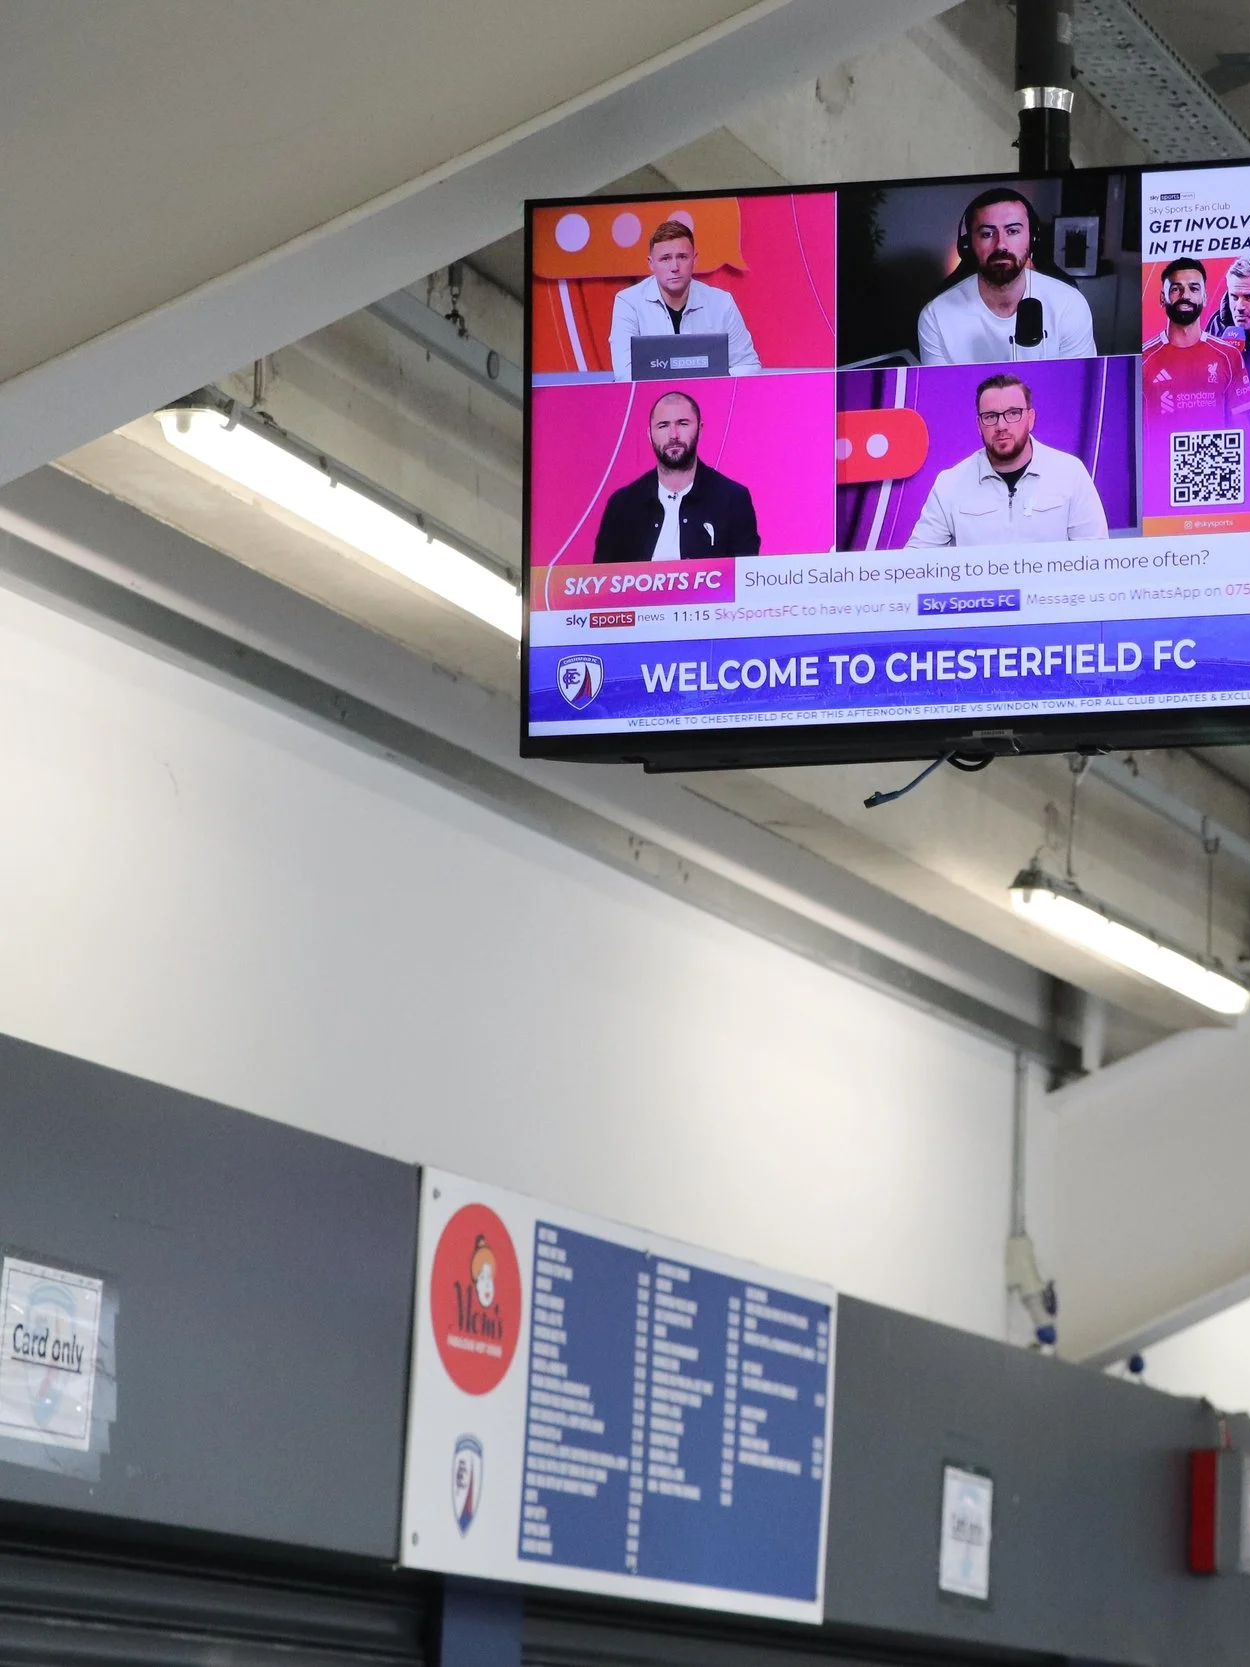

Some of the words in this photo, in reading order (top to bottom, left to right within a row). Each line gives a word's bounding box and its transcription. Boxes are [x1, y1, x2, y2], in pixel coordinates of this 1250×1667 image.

[1149, 206, 1164, 215] Sky
[1165, 205, 1193, 214] Sports
[1211, 202, 1231, 211] Club
[1149, 219, 1183, 234] GET
[1149, 241, 1168, 255] IN
[1172, 239, 1205, 254] THE
[650, 358, 669, 369] sky
[672, 357, 708, 368] sports
[744, 569, 804, 587] Should
[808, 567, 854, 584] Salah
[859, 566, 880, 582] be
[884, 562, 961, 583] speaking
[964, 562, 983, 577] to
[988, 560, 1010, 575] be
[1013, 558, 1043, 574] the
[1047, 555, 1100, 572] media
[1104, 556, 1149, 570] more
[1152, 550, 1210, 567] often?
[563, 575, 608, 596] SKY
[609, 571, 690, 593] SPORTS
[693, 570, 723, 589] FC
[922, 598, 945, 613] Sky
[949, 596, 995, 612] Sports
[998, 595, 1016, 607] FC
[1026, 592, 1086, 606] Message
[1090, 592, 1105, 602] us
[1109, 590, 1126, 601] on
[1129, 587, 1200, 602] WhatsApp
[1204, 586, 1222, 597] on
[566, 614, 588, 628] sky
[591, 612, 633, 626] sports
[637, 612, 665, 622] news
[673, 610, 710, 622] 11:15
[715, 605, 799, 621] SkySportsFC
[802, 606, 816, 615] to
[820, 604, 851, 614] have
[856, 603, 883, 616] your
[888, 601, 911, 613] say
[640, 655, 819, 694] WELCOME
[829, 653, 876, 685] TO
[885, 641, 1143, 683] CHESTERFIELD
[1153, 638, 1197, 671] FC
[627, 718, 681, 728] WELCOME
[685, 716, 698, 725] TO
[702, 713, 778, 724] CHESTERFIELD
[781, 712, 794, 721] FC
[797, 711, 818, 720] FOR
[821, 709, 844, 719] THIS
[847, 707, 921, 717] AFTERNOON'S
[923, 704, 967, 715] FIXTURE
[970, 703, 984, 713] VS
[986, 701, 1039, 712] SWINDON
[1080, 699, 1102, 708] FOR
[1104, 697, 1123, 706] ALL
[1127, 696, 1156, 705] CLUB
[1158, 694, 1207, 704] UPDATES
[1210, 693, 1217, 701] &
[12, 1323, 50, 1359] Card
[51, 1333, 84, 1374] only
